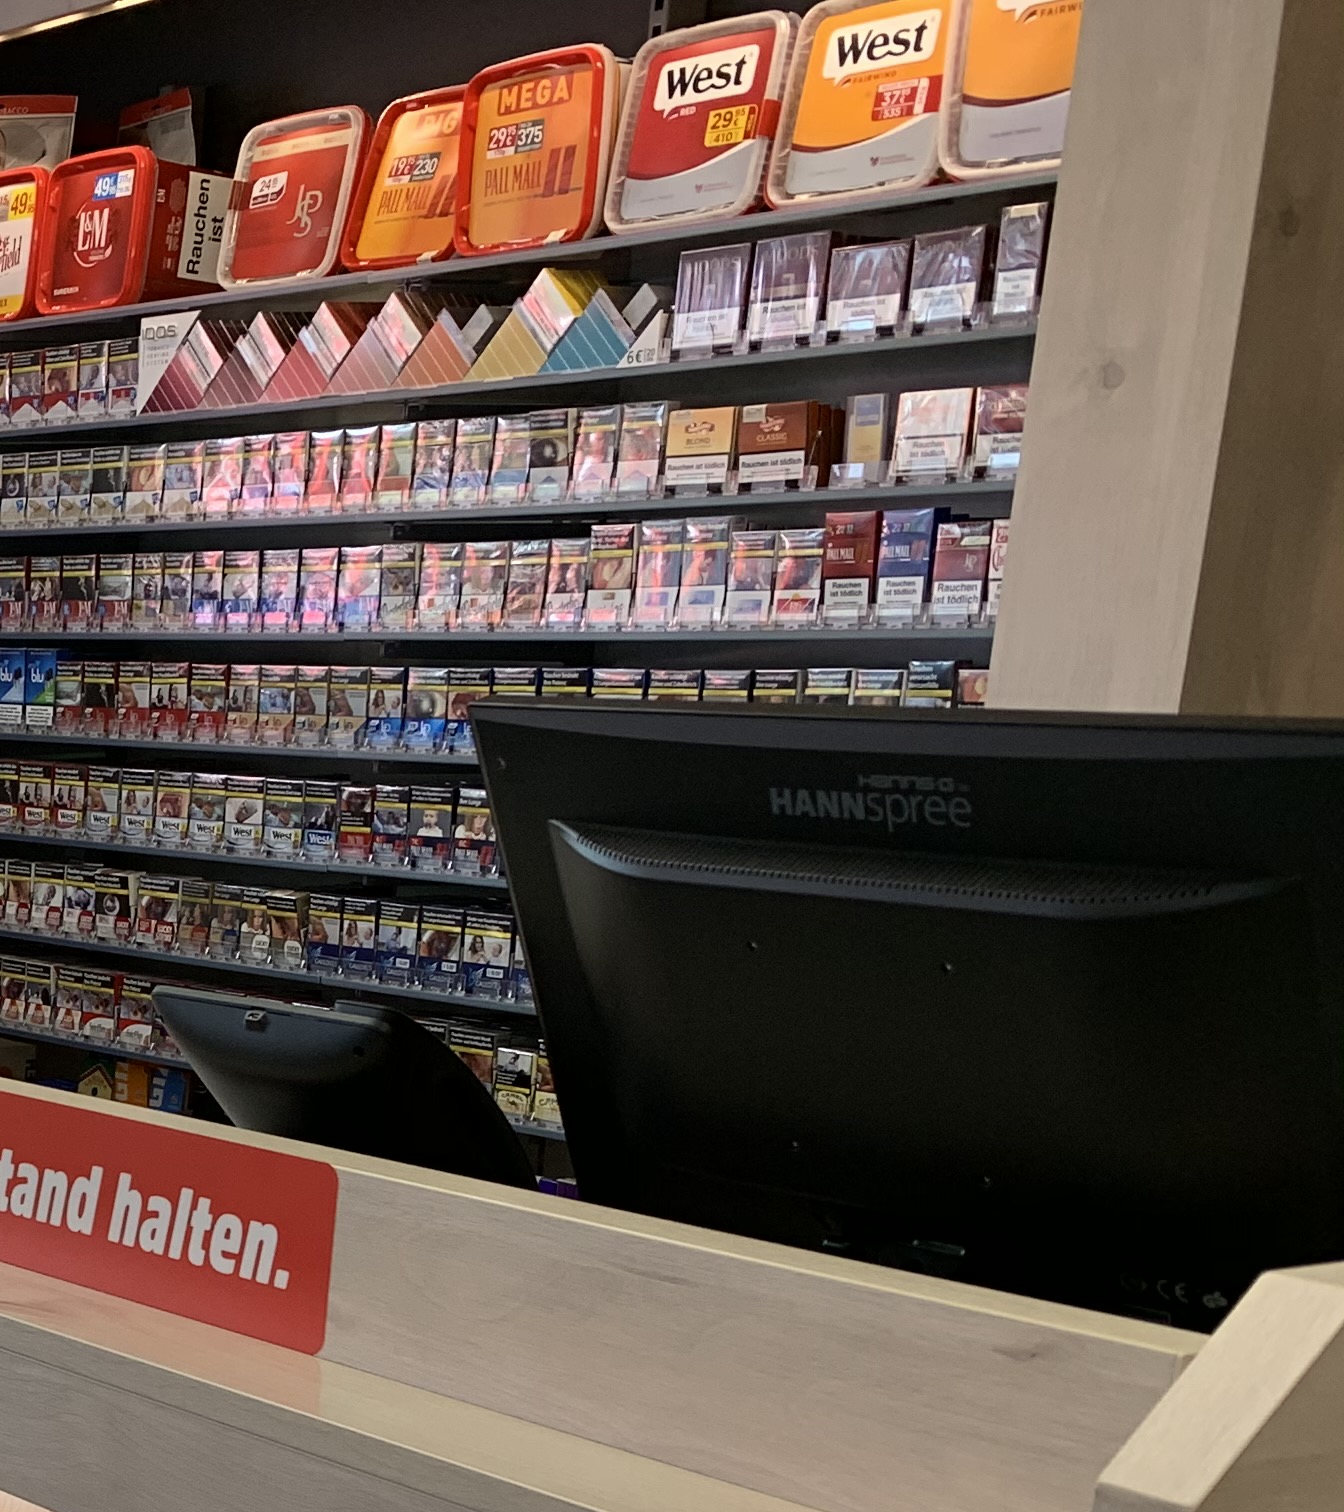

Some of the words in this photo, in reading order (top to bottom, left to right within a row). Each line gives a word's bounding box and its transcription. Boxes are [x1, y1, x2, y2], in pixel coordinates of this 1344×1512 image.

[837, 20, 928, 66] West
[500, 76, 570, 114] MEGA
[666, 51, 748, 96] West
[518, 126, 544, 146] 375
[78, 206, 109, 251] L&M
[187, 179, 211, 275] Rauchen
[210, 215, 224, 243] ist
[756, 433, 787, 443] CLASSIC
[770, 787, 972, 832] HANNspree
[107, 1172, 290, 1290] halten.
